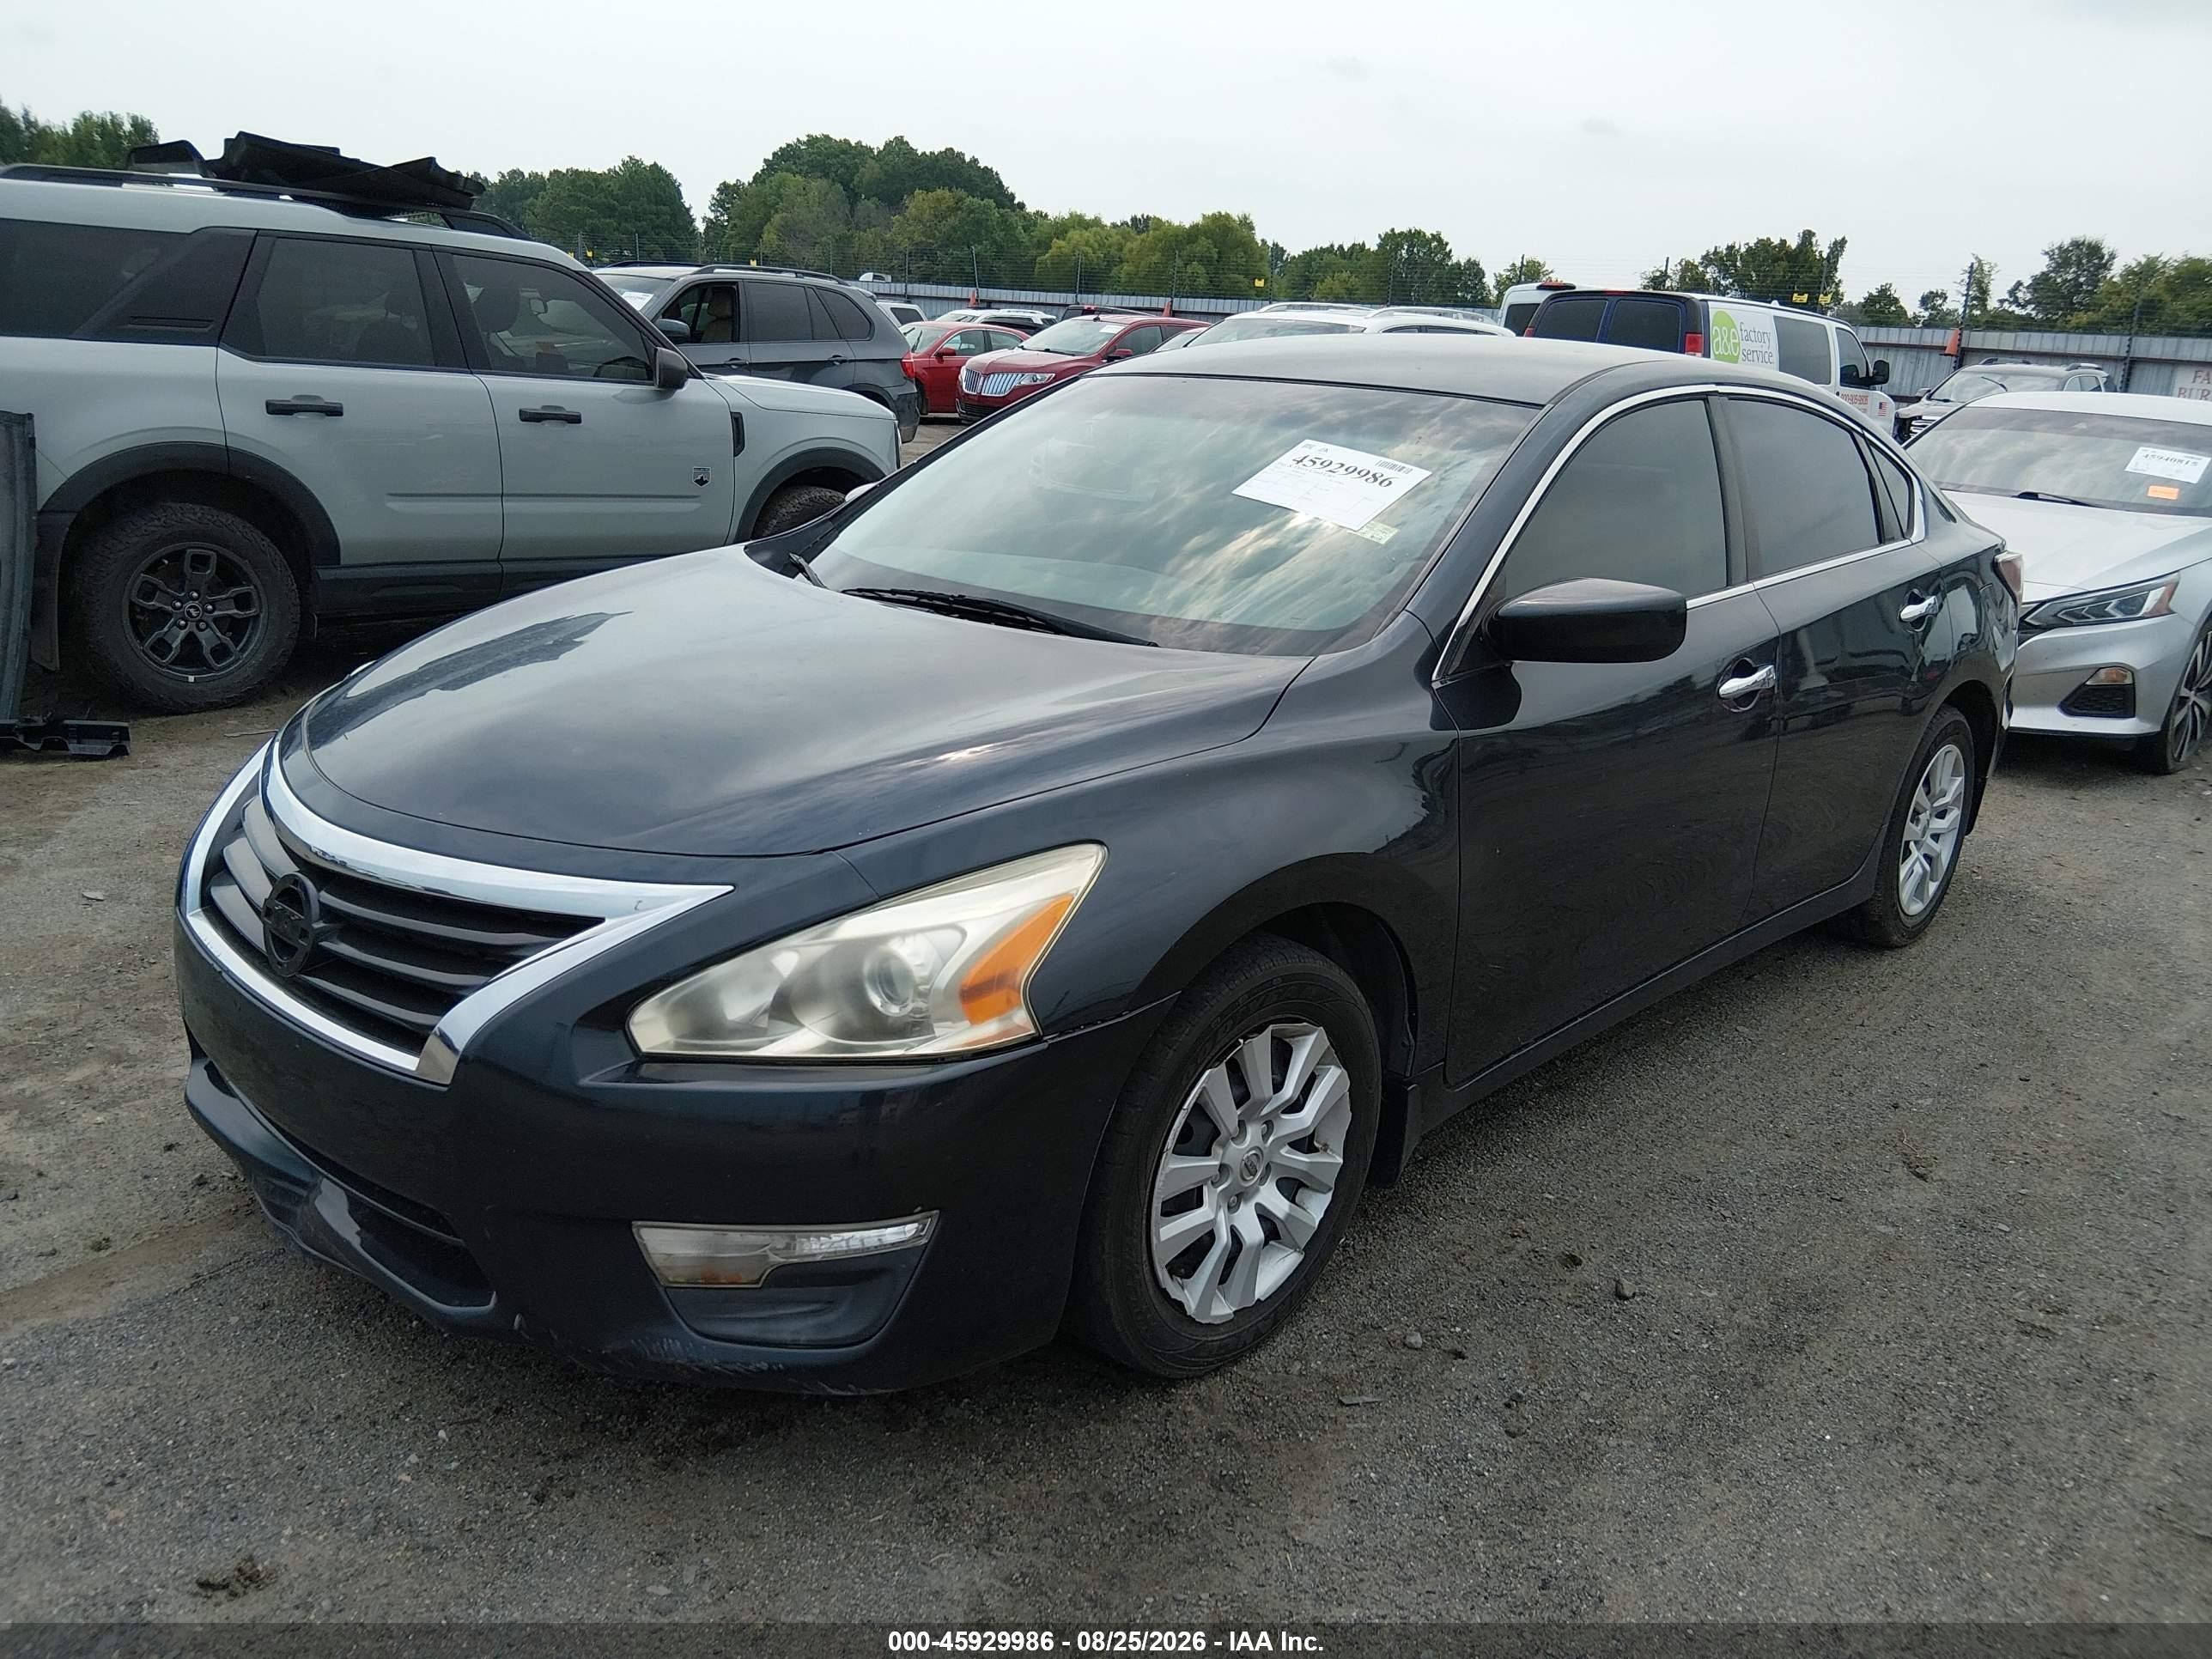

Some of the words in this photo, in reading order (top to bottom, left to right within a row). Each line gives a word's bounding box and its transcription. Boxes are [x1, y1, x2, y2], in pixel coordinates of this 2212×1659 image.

[1712, 325, 1739, 356] a&e
[1740, 321, 1771, 349] factory
[1741, 348, 1773, 364] service
[1291, 453, 1400, 488] 45929986
